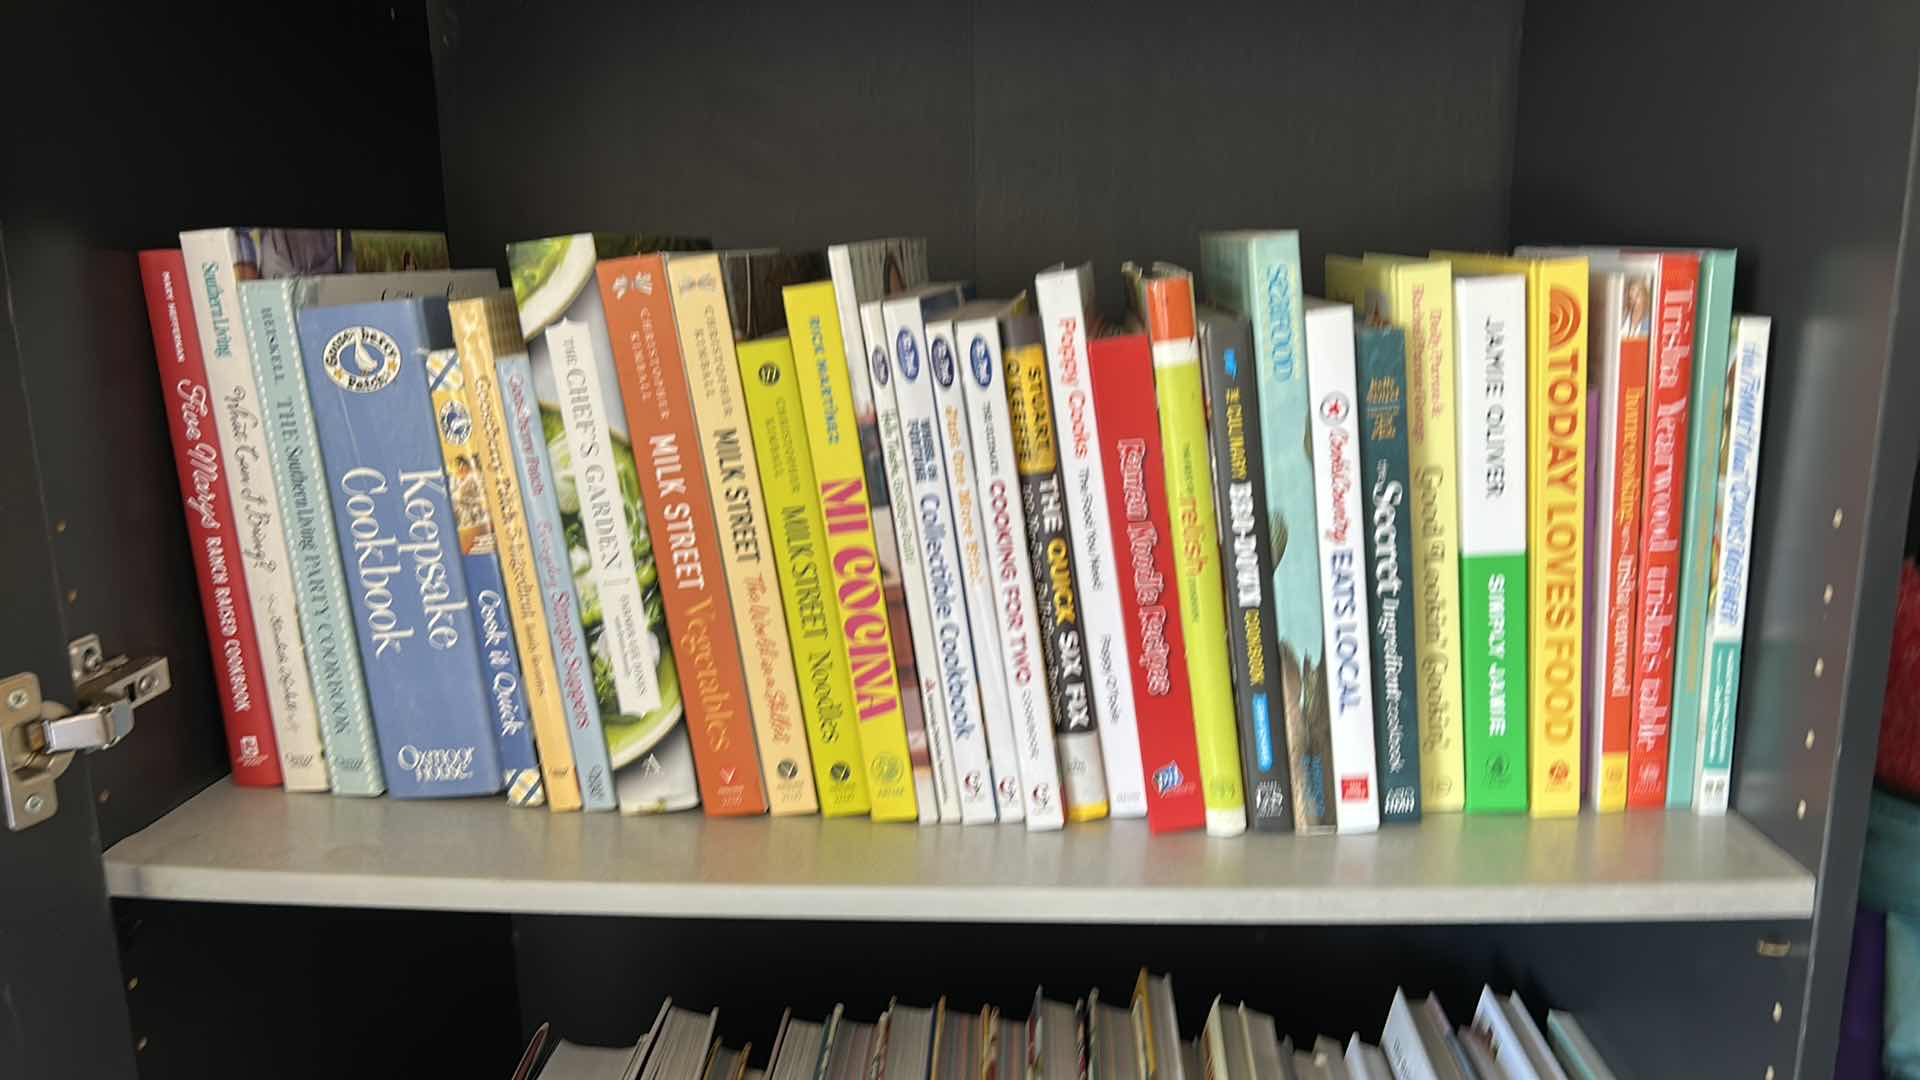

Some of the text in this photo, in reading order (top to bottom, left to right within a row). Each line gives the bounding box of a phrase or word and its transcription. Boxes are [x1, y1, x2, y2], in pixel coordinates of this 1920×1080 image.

[202, 263, 232, 359] Southern Living
[261, 307, 284, 384] HEISKELL
[810, 316, 824, 355] RICK
[1658, 280, 1695, 389] Trisha
[630, 330, 651, 401] KIMBALL
[640, 307, 670, 422] CHRISTOPHER
[694, 328, 714, 399] KIMBALL
[703, 305, 734, 417] CHRISTOPHER
[1058, 316, 1078, 386] Poppy
[1068, 390, 1089, 459] Cooks
[1484, 316, 1505, 500] JAMIE OLIVER
[178, 380, 220, 529] Five Marys
[224, 386, 258, 440] What
[276, 397, 298, 442] THE
[562, 339, 622, 569] THE CHEF'S GARDEN
[713, 428, 747, 484] MILK
[1028, 366, 1050, 452] STUART
[235, 444, 259, 481] Can
[284, 446, 311, 510] Southern
[820, 478, 870, 536] MI
[1414, 466, 1444, 538] Good
[1648, 396, 1687, 552] Yearwood
[206, 536, 228, 584] RANCH
[296, 508, 320, 551] Living
[341, 466, 415, 659] Cookbook
[399, 468, 469, 650] Keepsake
[726, 487, 761, 564] STREET
[780, 505, 814, 562] MILK
[989, 480, 1018, 580] COOKING
[1117, 438, 1170, 696] Ramen Noodle Recipes
[1179, 496, 1208, 577] relish
[1226, 403, 1248, 480] CULINARY
[1244, 609, 1264, 686] COOKBOOK
[1372, 480, 1403, 598] Secret
[1544, 350, 1579, 744] TODAY LOVES FOOD
[215, 588, 237, 636] RAISED
[304, 556, 330, 621] PARTY
[649, 432, 734, 752] MILK STREET Vegetables
[792, 564, 829, 640] STREET
[920, 495, 976, 740] Collectible Cookbook
[1003, 584, 1023, 631] FOR
[1040, 474, 1090, 730] THE QUICK SIX FIX
[1330, 548, 1356, 618] EATS
[1642, 565, 1673, 673] trisha's
[224, 640, 250, 712] COOKBOOK
[318, 623, 352, 736] COOKBOOK
[478, 590, 524, 736] Cook it Quick
[832, 546, 898, 723] COCINA
[1014, 632, 1032, 688] TWO
[1336, 622, 1360, 716] LOCAL
[1378, 598, 1403, 702] Ingredient
[1488, 573, 1507, 736] SIMPLY JAMIE
[808, 650, 842, 744] Noodles
[1637, 678, 1668, 752] table
